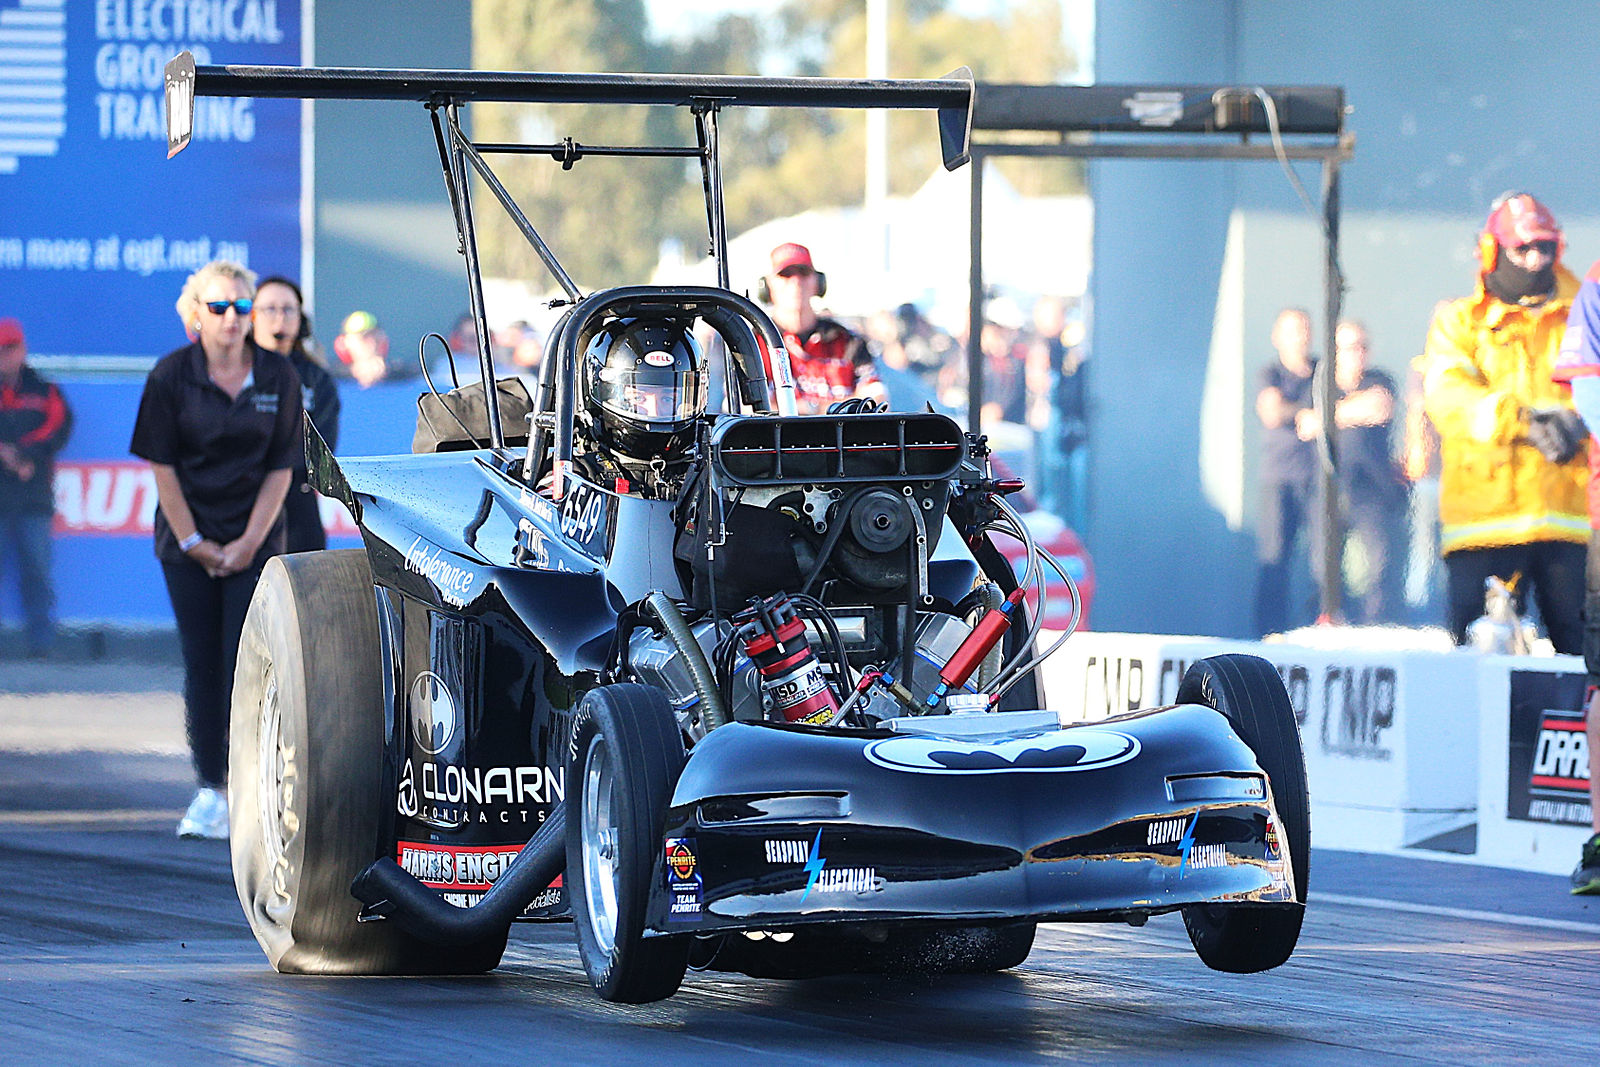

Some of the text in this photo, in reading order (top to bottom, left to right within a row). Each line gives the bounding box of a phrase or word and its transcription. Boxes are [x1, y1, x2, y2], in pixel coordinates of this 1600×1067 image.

[95, 0, 283, 43] ELECTRICAL
[96, 42, 212, 91] GROP
[95, 92, 256, 143] TRAIING
[561, 484, 602, 544] 6549
[404, 535, 474, 593] Intolerance
[423, 762, 566, 804] CLONARN
[423, 805, 546, 823] CONTRACTS
[1147, 818, 1187, 845] SEASPRAY
[670, 855, 696, 866] PENRITE
[764, 840, 809, 863] SEASPRAY
[1190, 843, 1228, 869] ELECTRICAL
[401, 848, 455, 885] HARRIS
[818, 867, 876, 893] ELECTRICAL
[671, 903, 701, 913] PENRITE
[676, 894, 696, 904] TEAM
